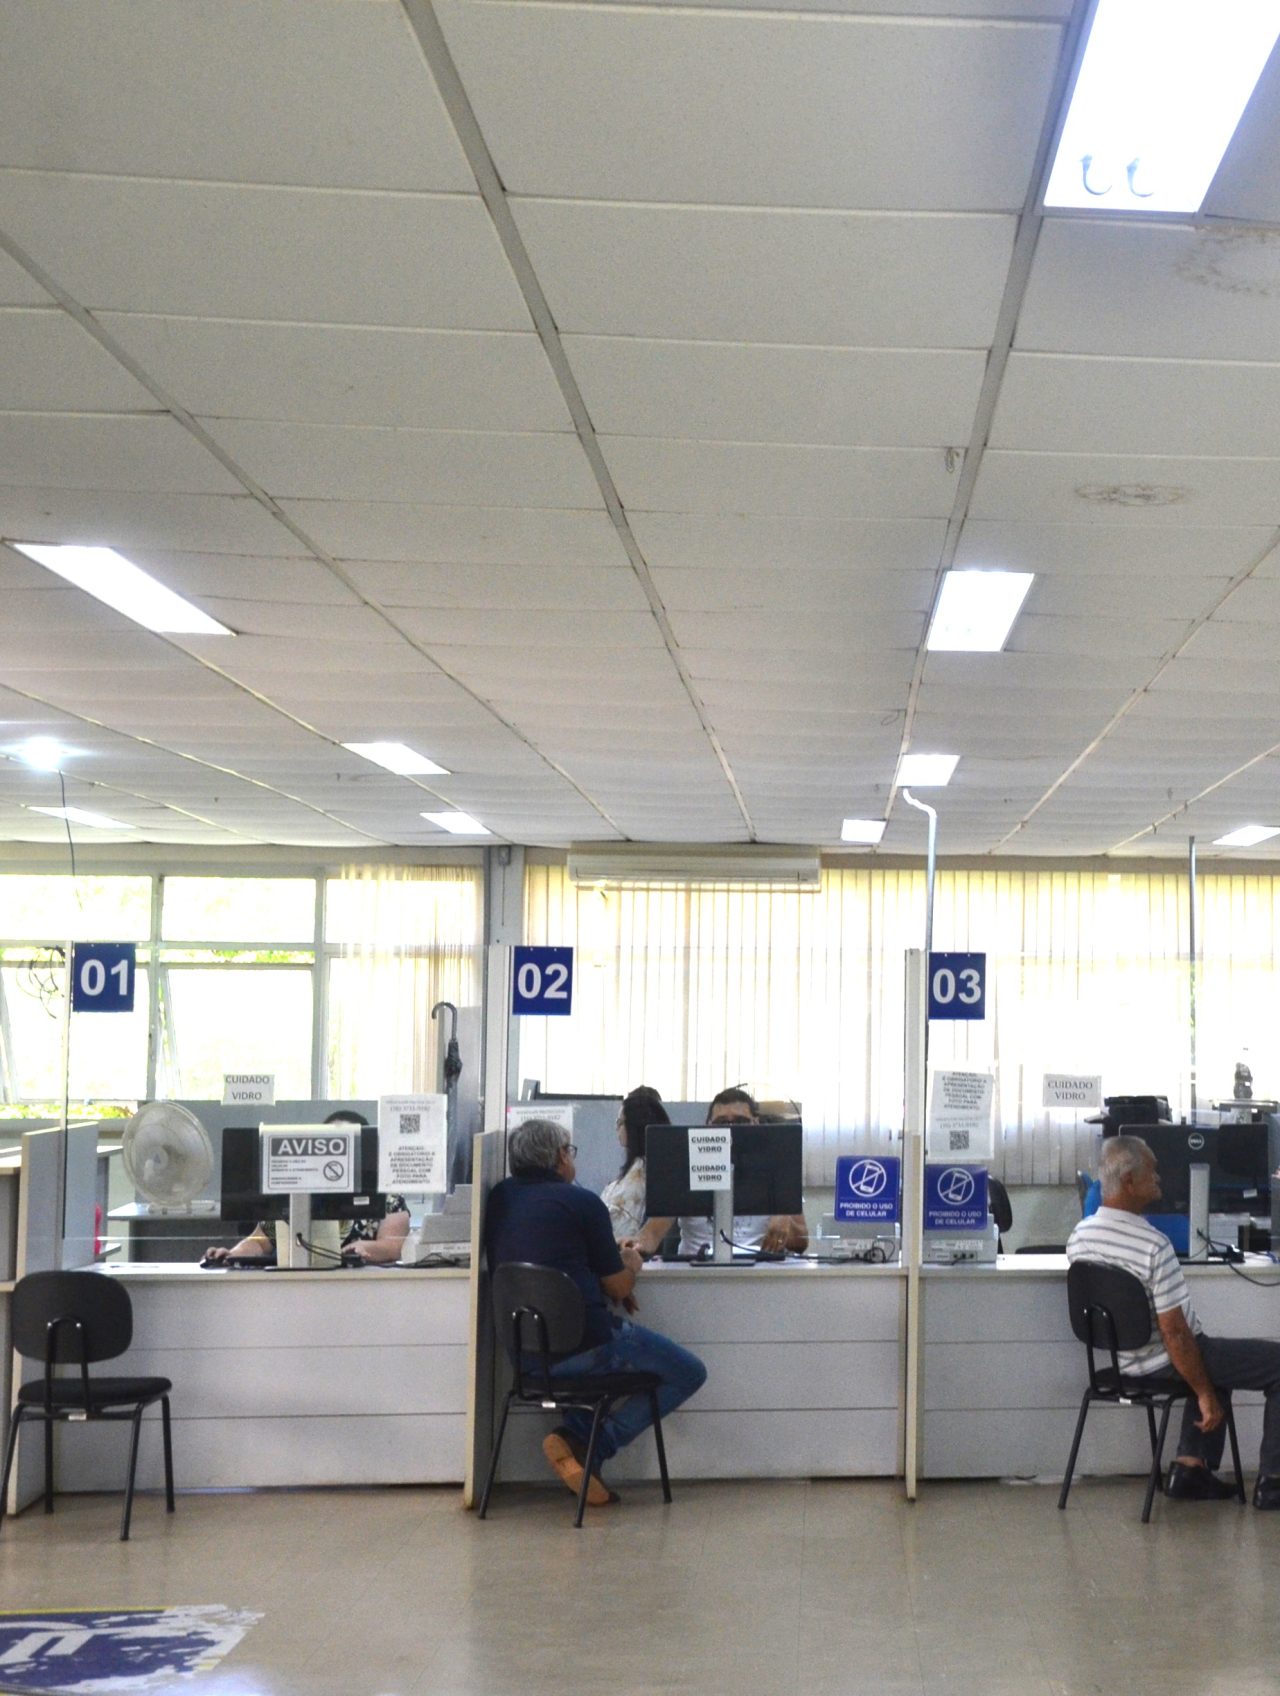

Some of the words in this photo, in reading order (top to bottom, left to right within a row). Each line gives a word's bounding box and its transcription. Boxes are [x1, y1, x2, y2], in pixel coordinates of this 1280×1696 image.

[81, 958, 128, 996] 01
[518, 962, 568, 999] 02
[933, 968, 981, 1004] 03
[225, 1074, 270, 1085] CUIDADO
[1048, 1080, 1093, 1089] CUIDADO
[232, 1091, 262, 1100] VIDRO
[1054, 1091, 1086, 1100] VIDRO
[278, 1138, 345, 1155] AVISO
[691, 1164, 727, 1172] CUIDADO
